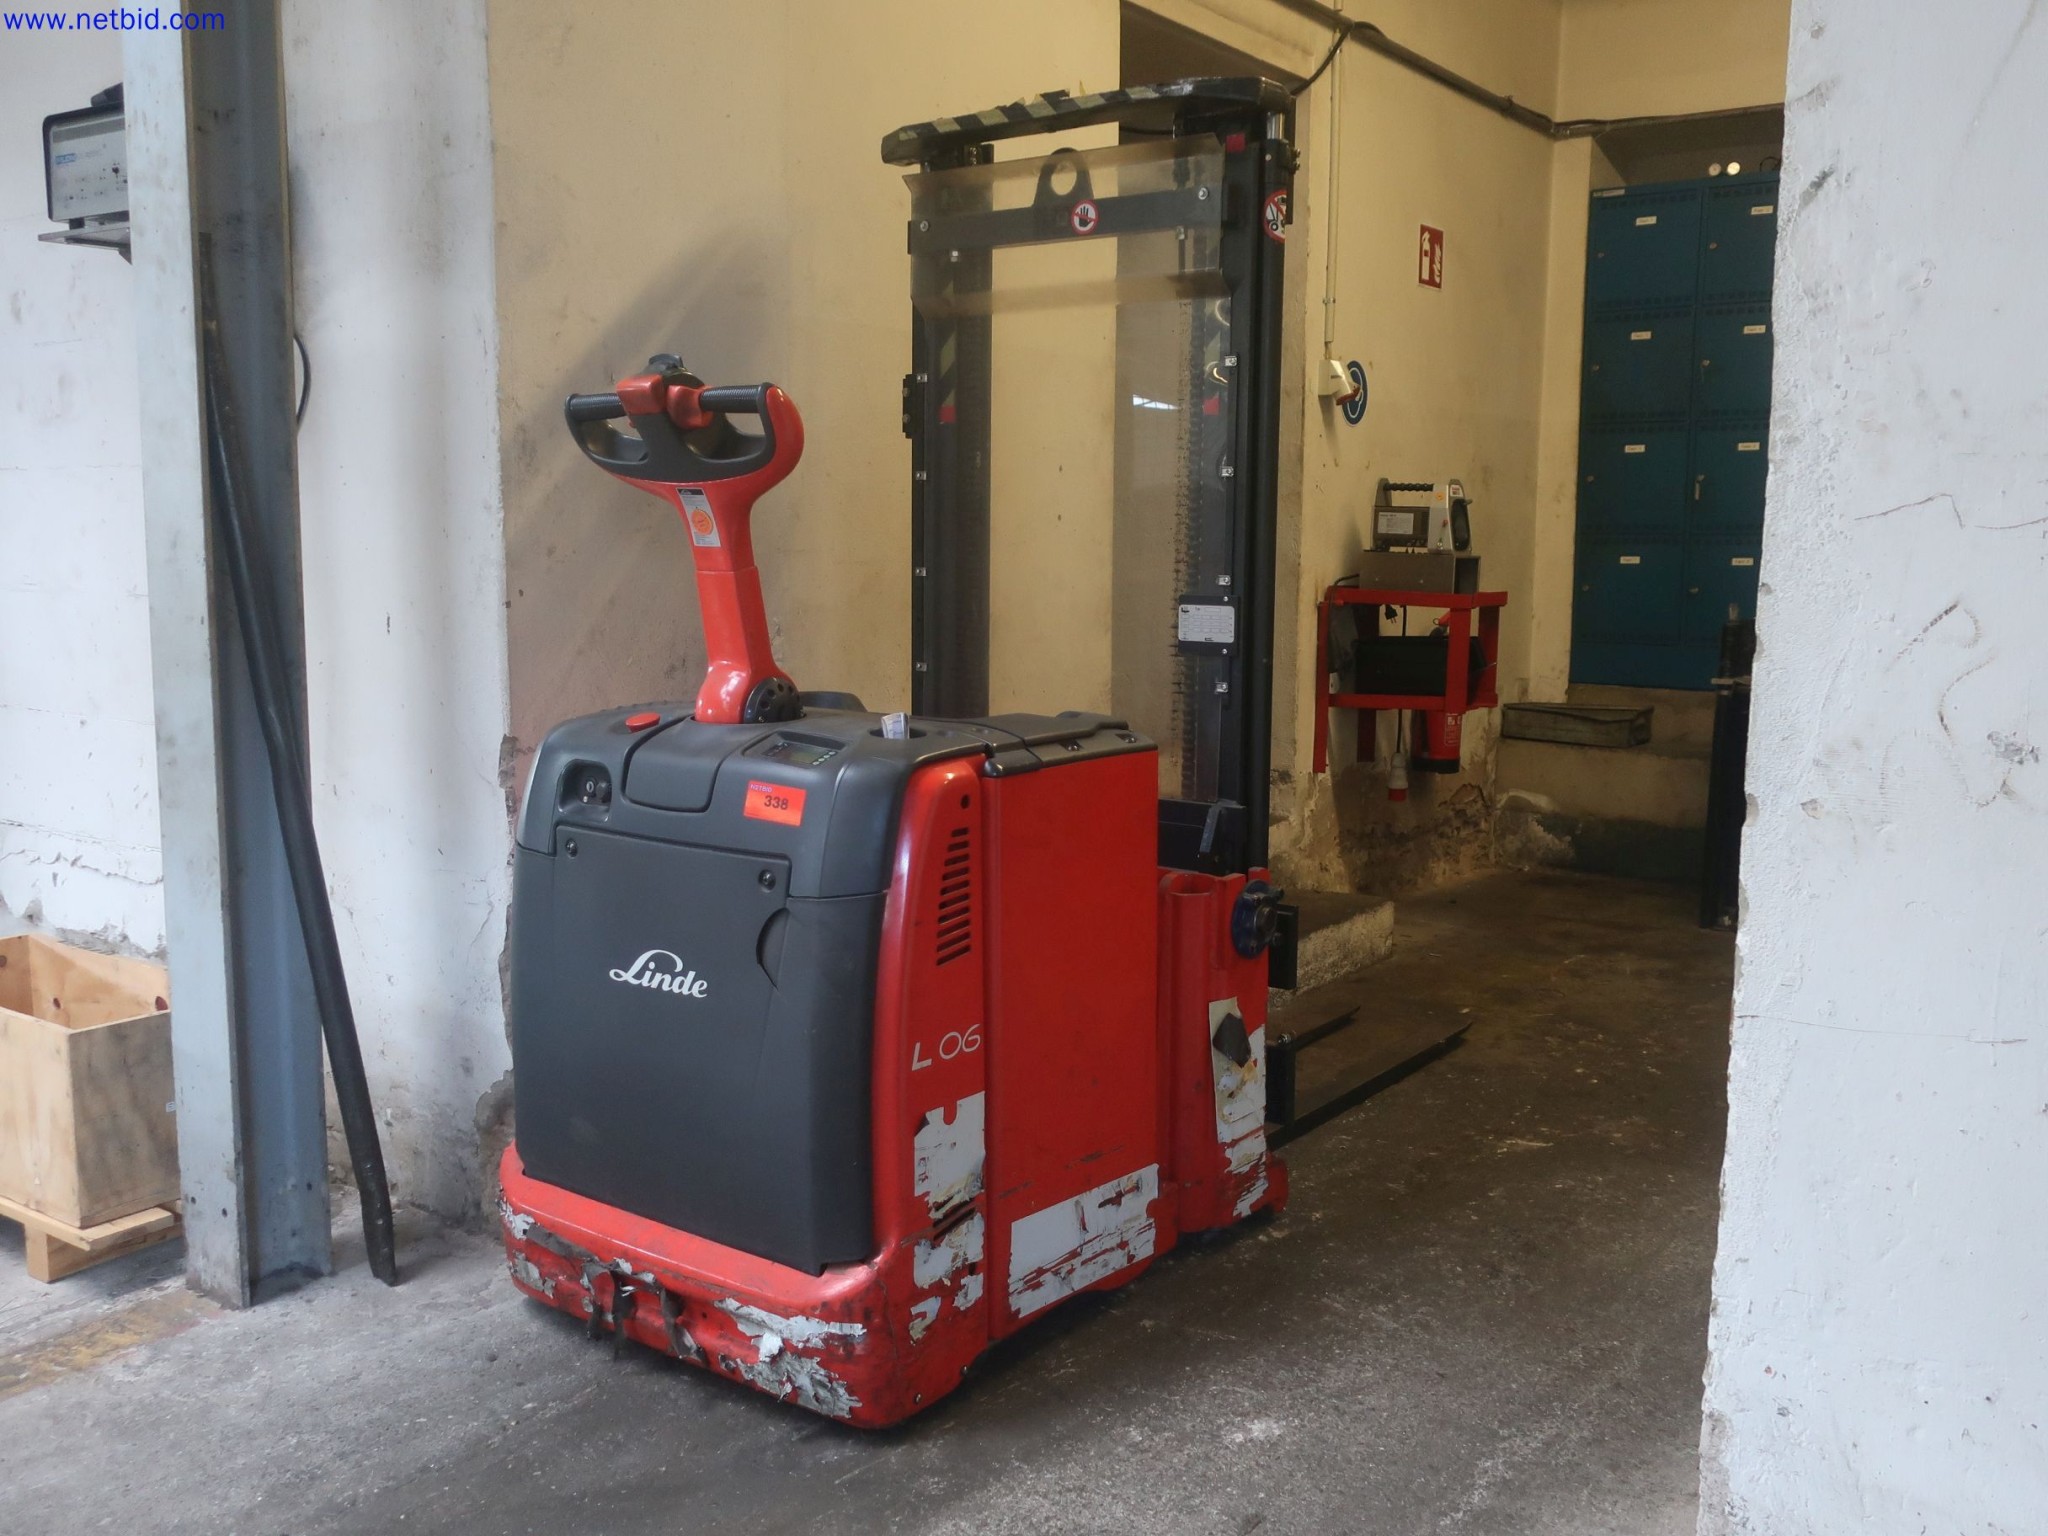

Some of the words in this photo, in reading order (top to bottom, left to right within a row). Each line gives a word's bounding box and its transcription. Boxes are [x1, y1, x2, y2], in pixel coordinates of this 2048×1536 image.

[764, 795, 789, 810] 338
[609, 949, 709, 998] Linde
[912, 1042, 932, 1071] L
[939, 1024, 981, 1060] 06
